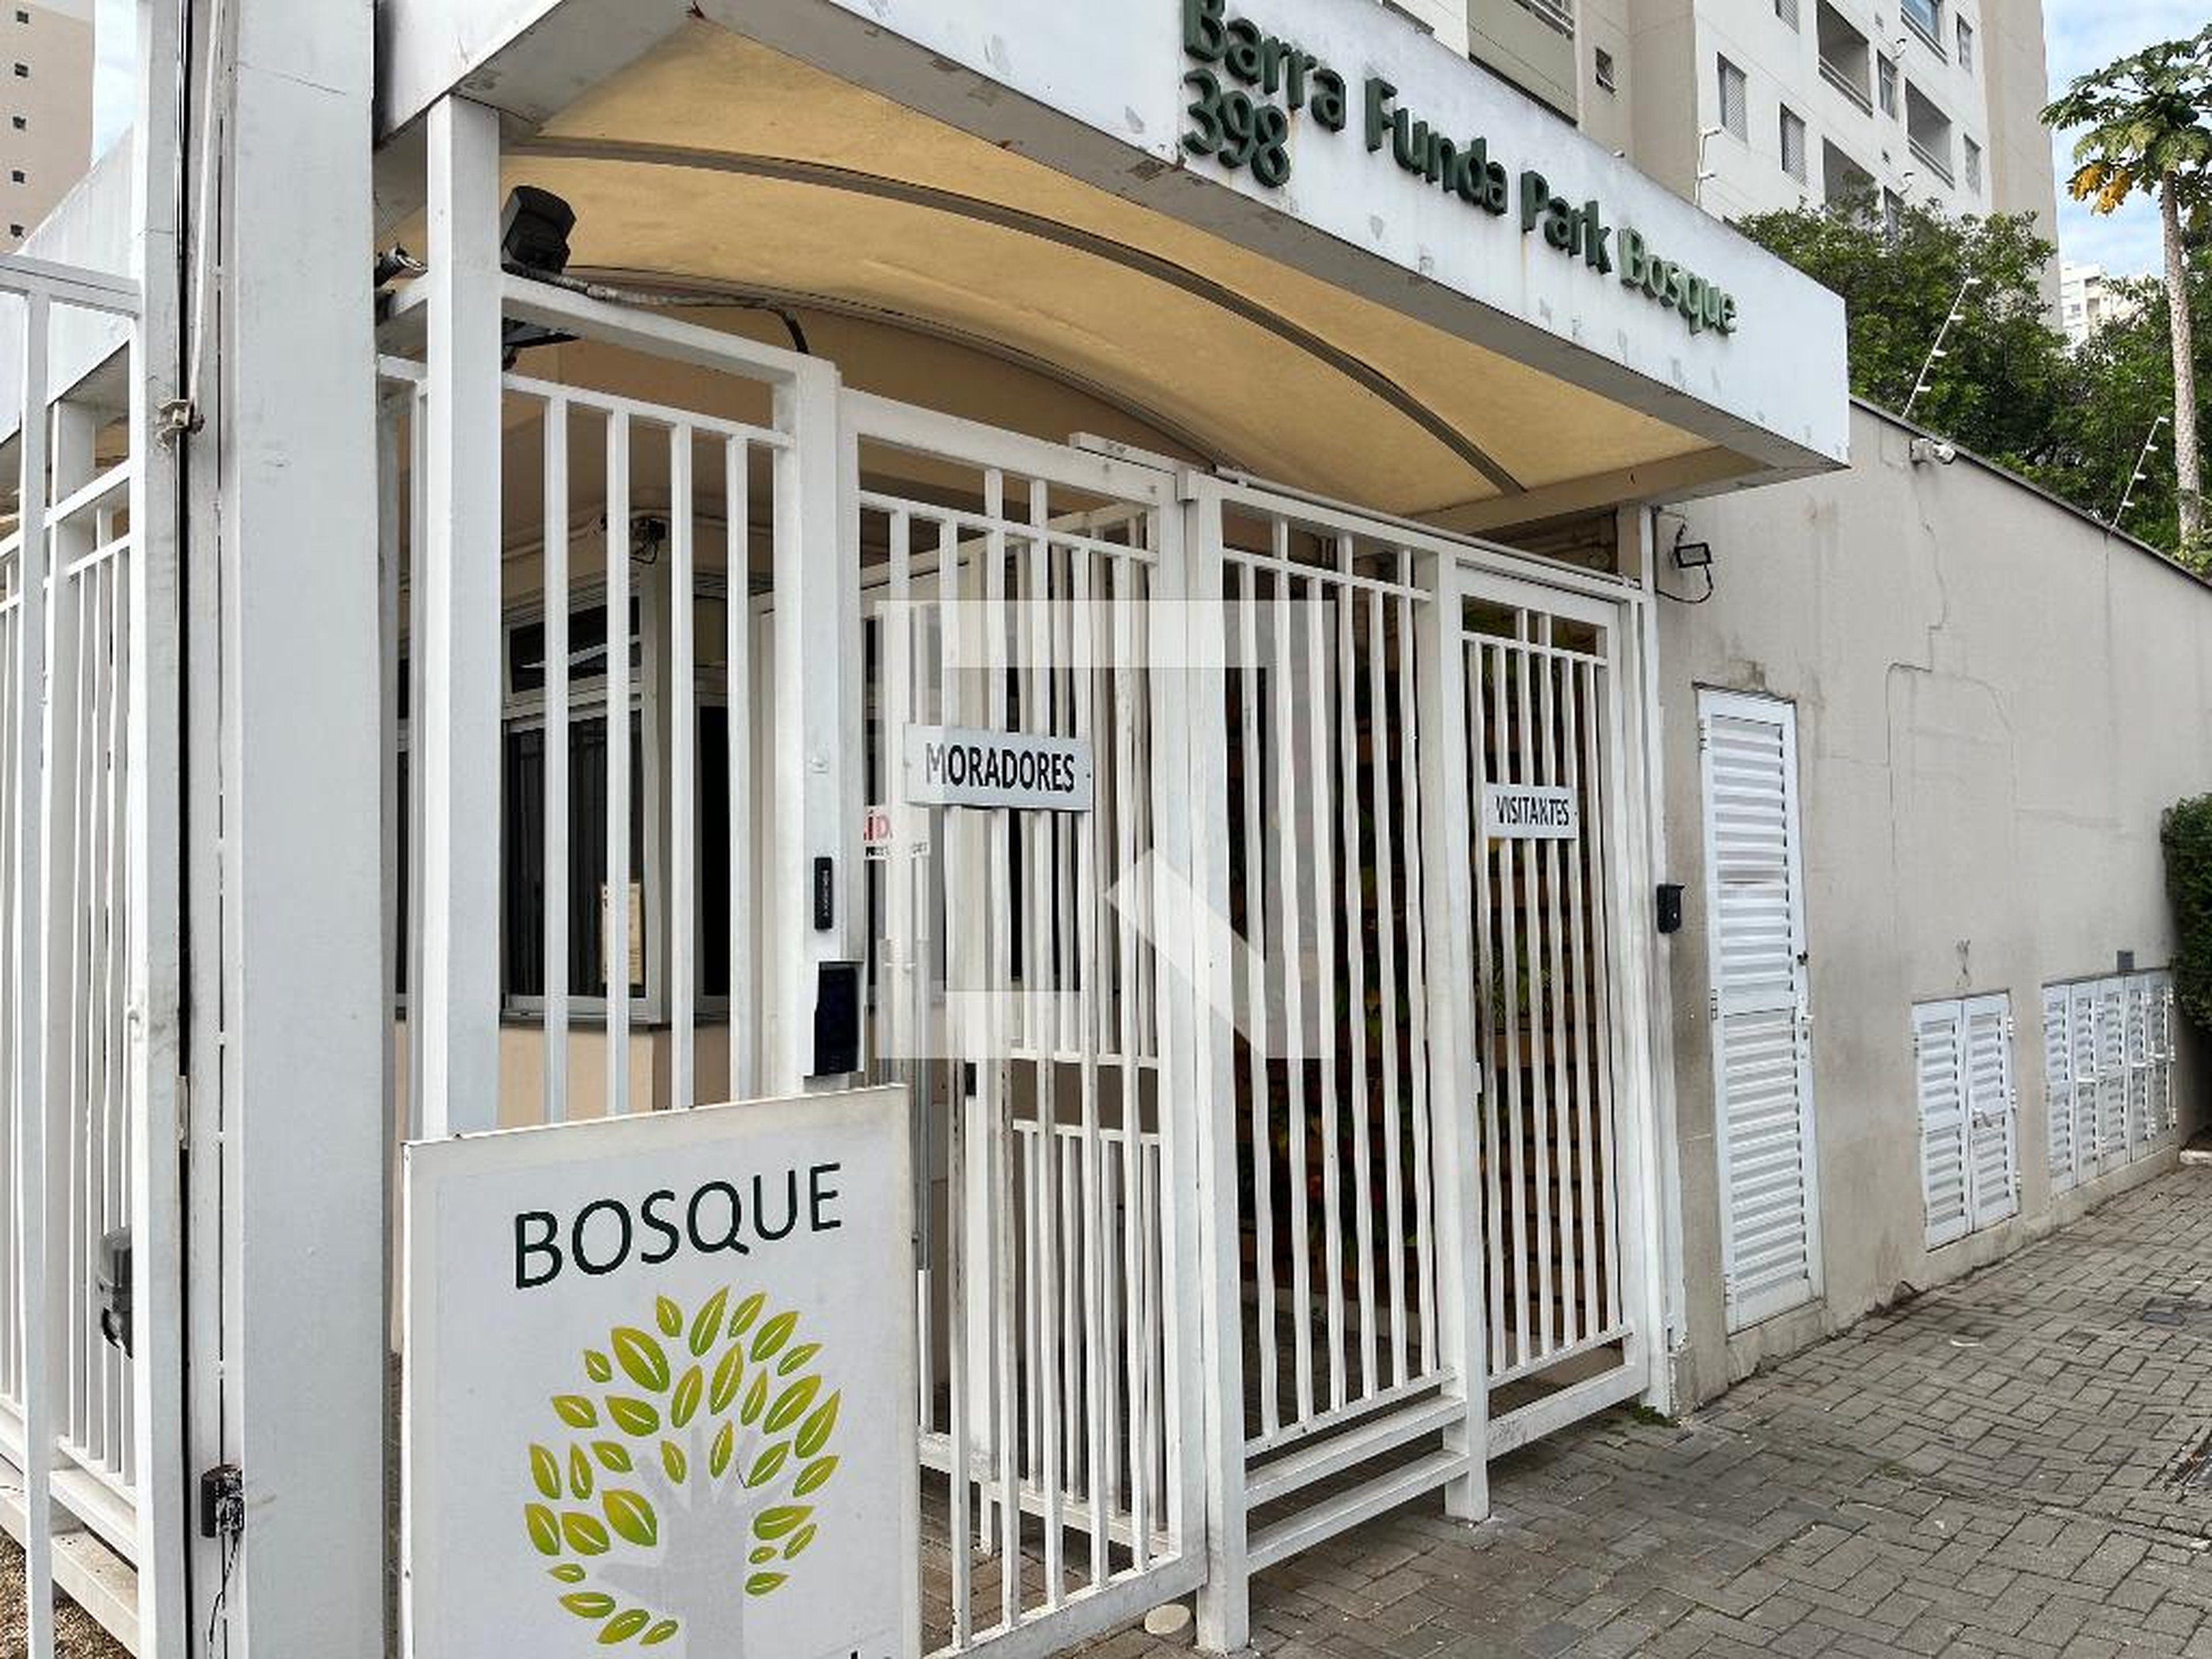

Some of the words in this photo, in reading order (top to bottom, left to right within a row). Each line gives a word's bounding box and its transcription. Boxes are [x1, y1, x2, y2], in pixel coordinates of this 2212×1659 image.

[1181, 67, 1291, 188] 398
[1183, 0, 1347, 133] Barra
[1365, 77, 1509, 217] Funda
[1520, 170, 1612, 275] Park
[1617, 227, 1737, 334] Bosque
[926, 742, 1075, 793] MORADORES
[1495, 795, 1570, 826] VISITANTES
[514, 1161, 843, 1290] BOSQUE
